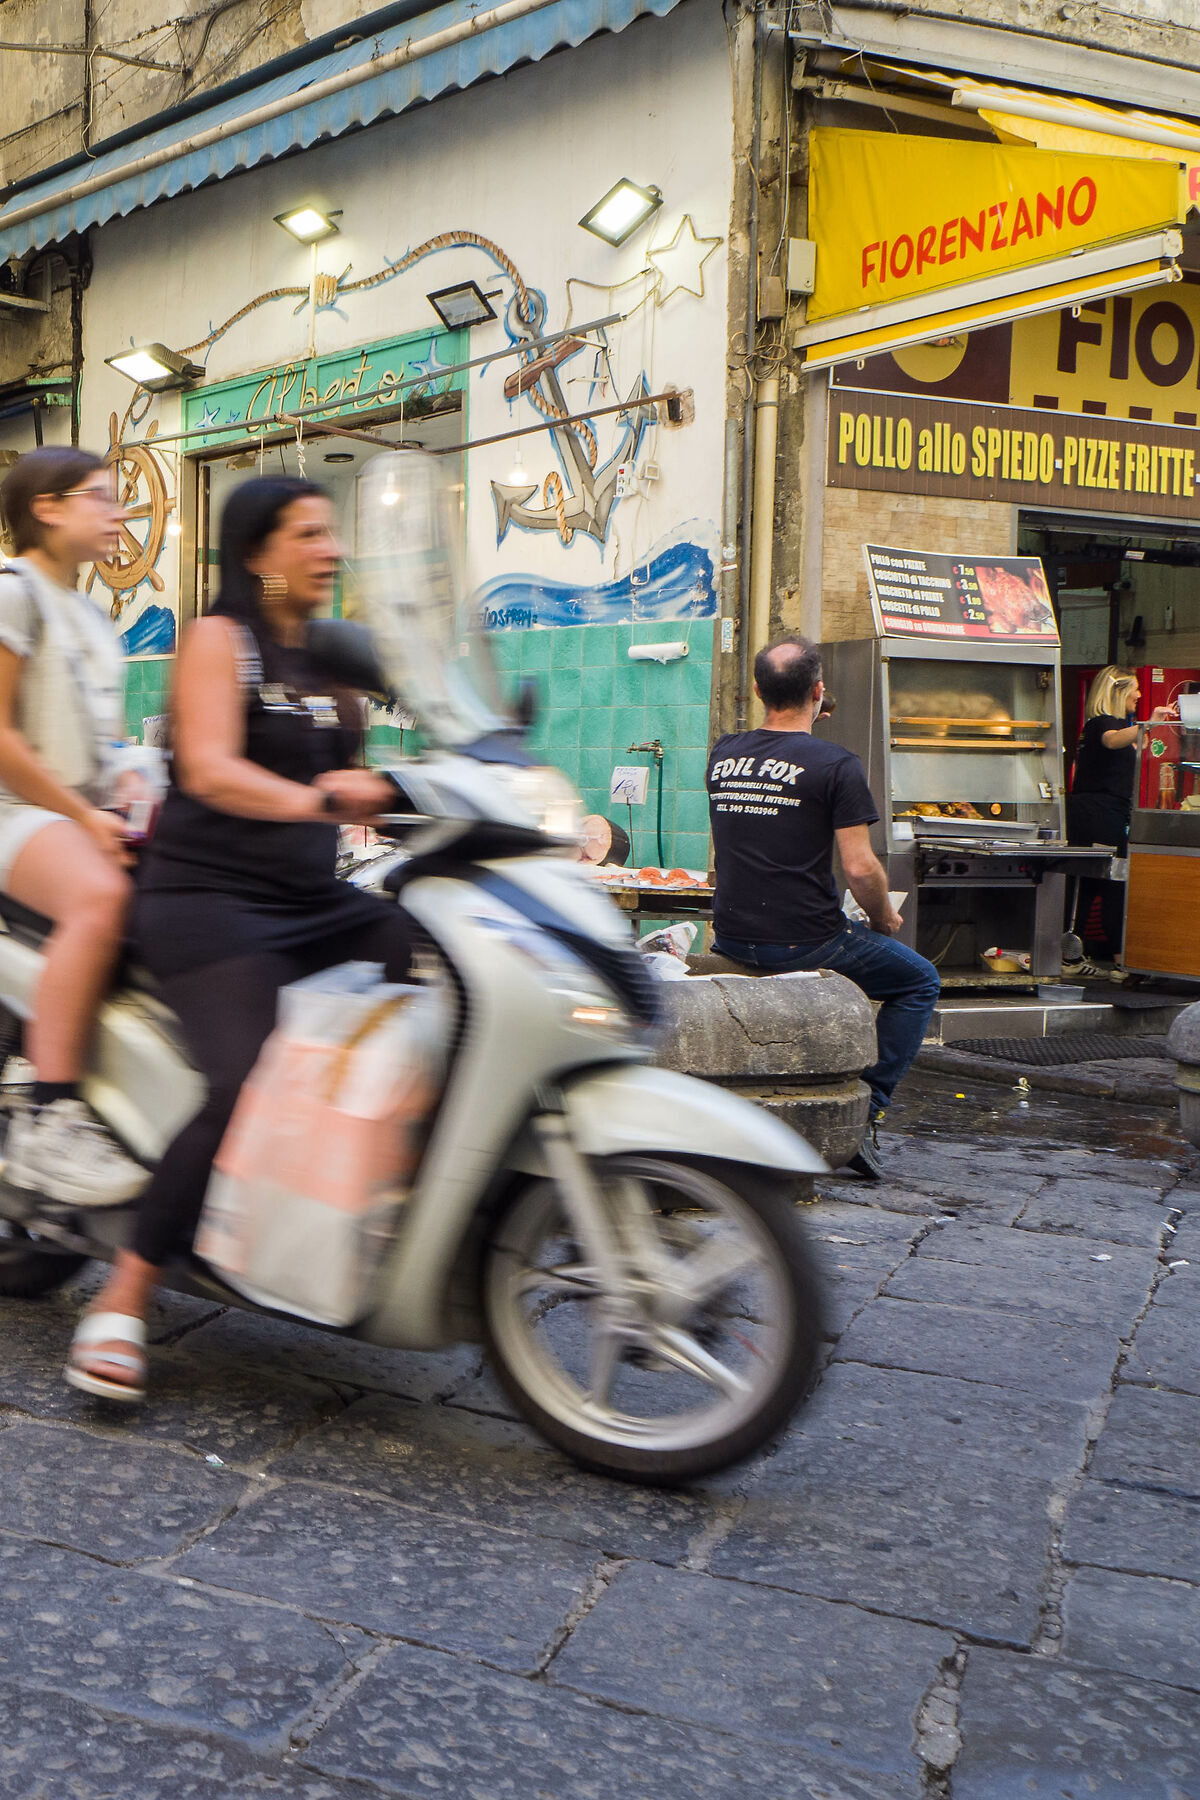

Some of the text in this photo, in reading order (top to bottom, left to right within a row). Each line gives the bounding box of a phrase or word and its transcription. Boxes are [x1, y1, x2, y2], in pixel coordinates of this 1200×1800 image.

[861, 176, 1097, 288] FIORENZANO
[1056, 296, 1200, 390] FIO
[838, 412, 912, 470] POLLO
[919, 422, 966, 475] allo
[870, 554, 890, 566] POLLO
[903, 559, 927, 571] PATATE
[920, 591, 945, 602] PATATE
[920, 605, 941, 616] POLLO
[710, 757, 805, 785] EDIL FOX
[762, 782, 783, 792] FABIO
[764, 794, 802, 807] INTERNE
[728, 804, 744, 813] 349
